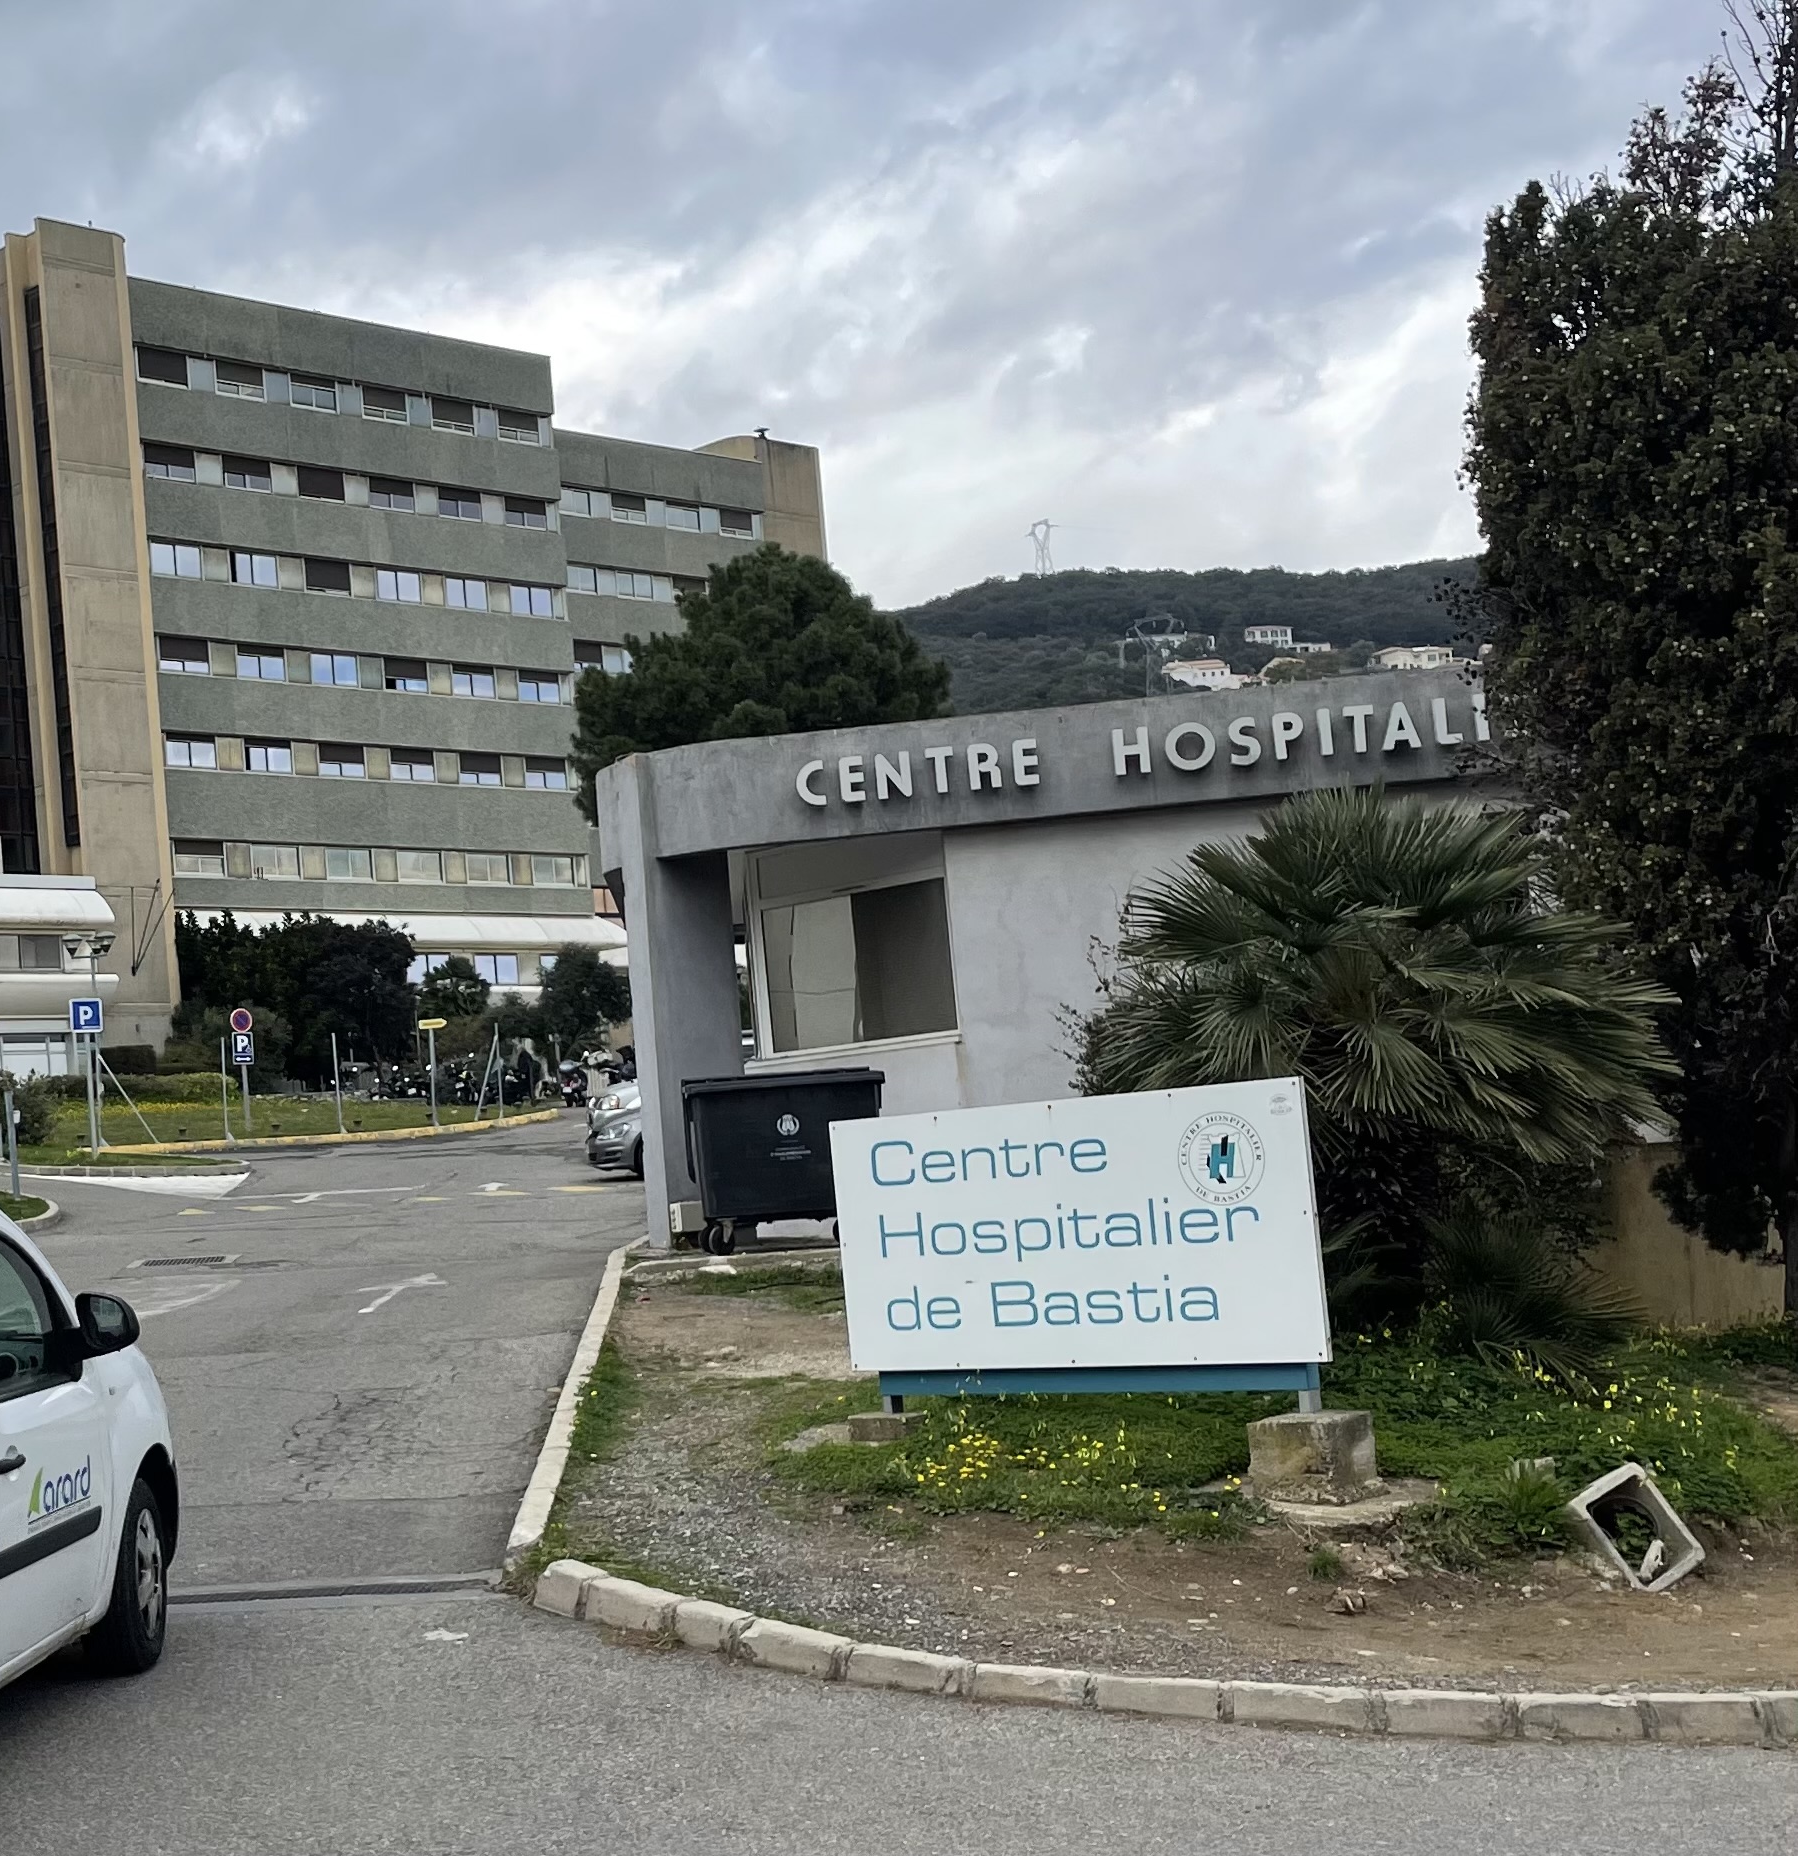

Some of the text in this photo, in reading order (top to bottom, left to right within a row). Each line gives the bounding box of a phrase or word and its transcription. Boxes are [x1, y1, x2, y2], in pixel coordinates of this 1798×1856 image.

[796, 693, 1491, 806] CENTRE HOSPITALI
[79, 1005, 94, 1025] P
[237, 1035, 249, 1052] P
[871, 1137, 1108, 1187] Centre
[1214, 1185, 1251, 1203] BASTIA
[879, 1197, 1260, 1262] Hospitalier
[887, 1274, 1220, 1331] de Bastia
[43, 1454, 91, 1513] arard
